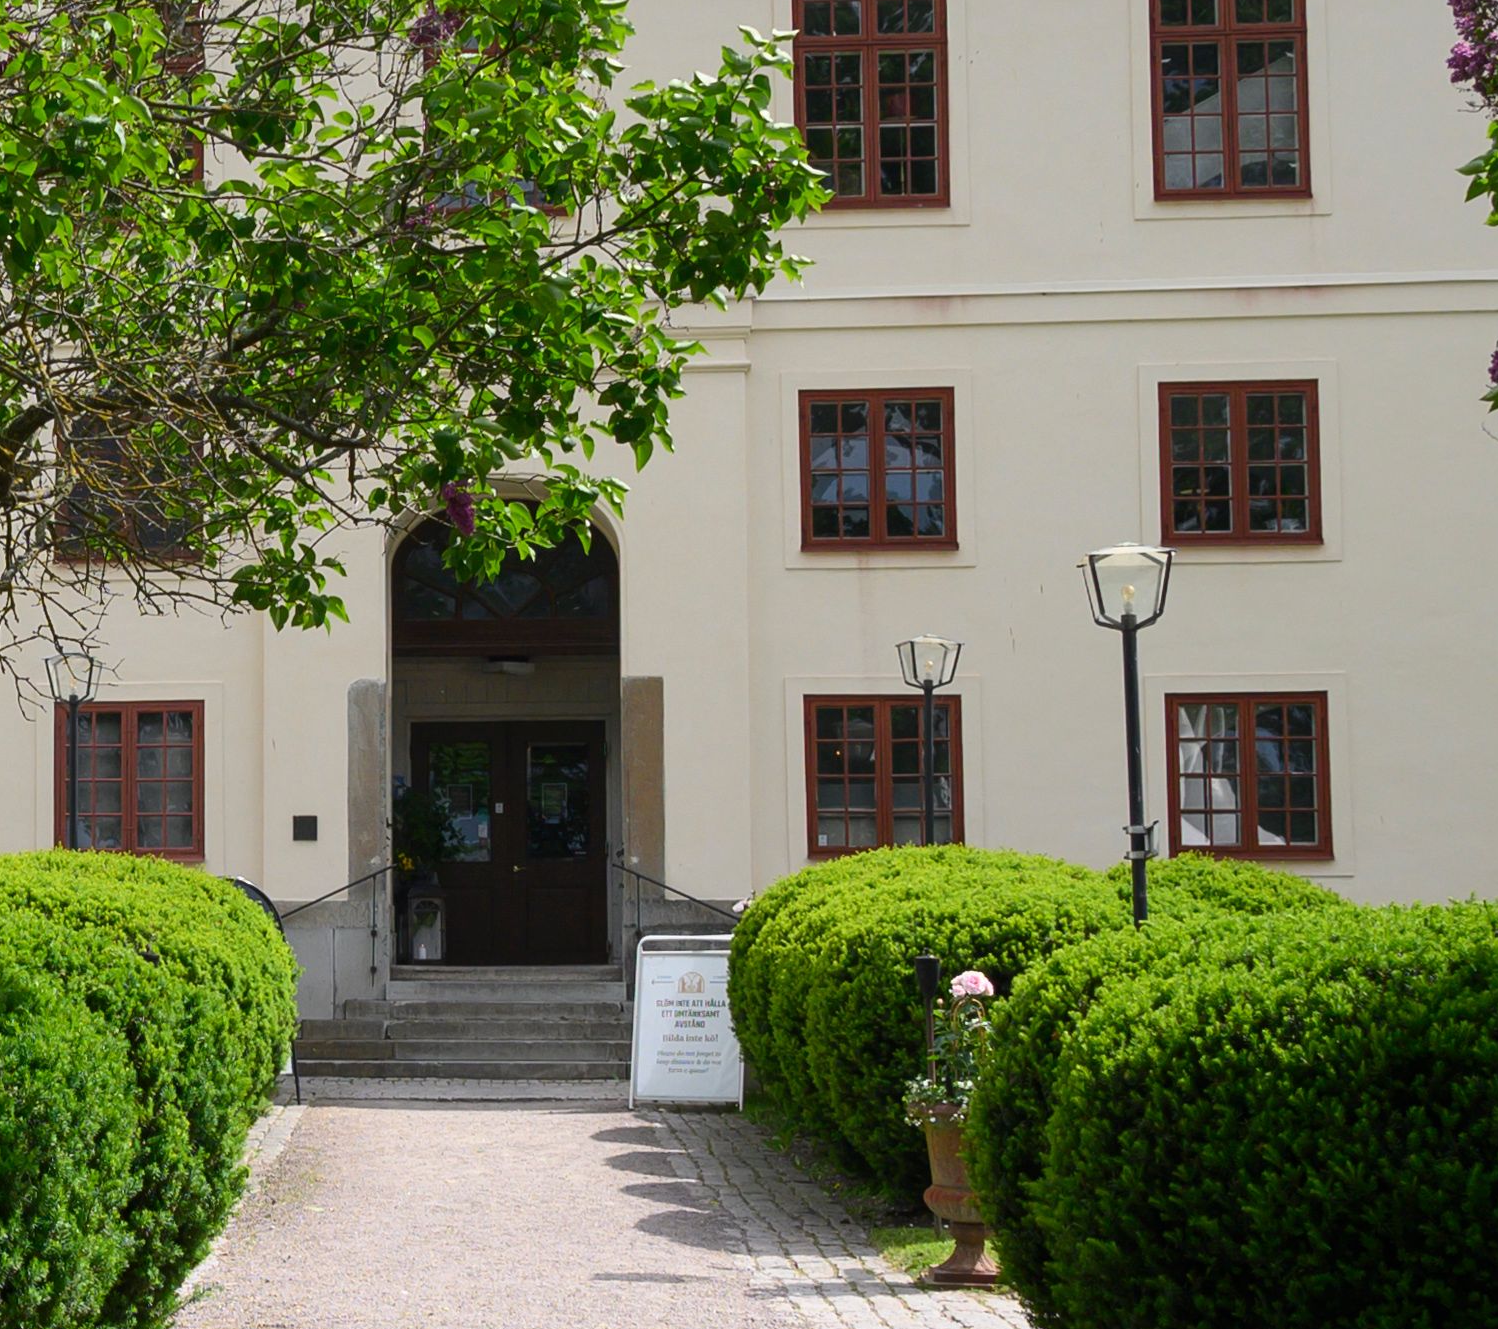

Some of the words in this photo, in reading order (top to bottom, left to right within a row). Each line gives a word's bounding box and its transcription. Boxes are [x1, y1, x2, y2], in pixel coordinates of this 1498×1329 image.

[675, 999, 690, 1007] INTE
[691, 999, 703, 1007] ATT
[704, 997, 726, 1007] HÅLLA
[661, 1010, 673, 1018] ETT
[674, 1018, 706, 1028] AVSTÅND
[685, 1033, 703, 1042] inte
